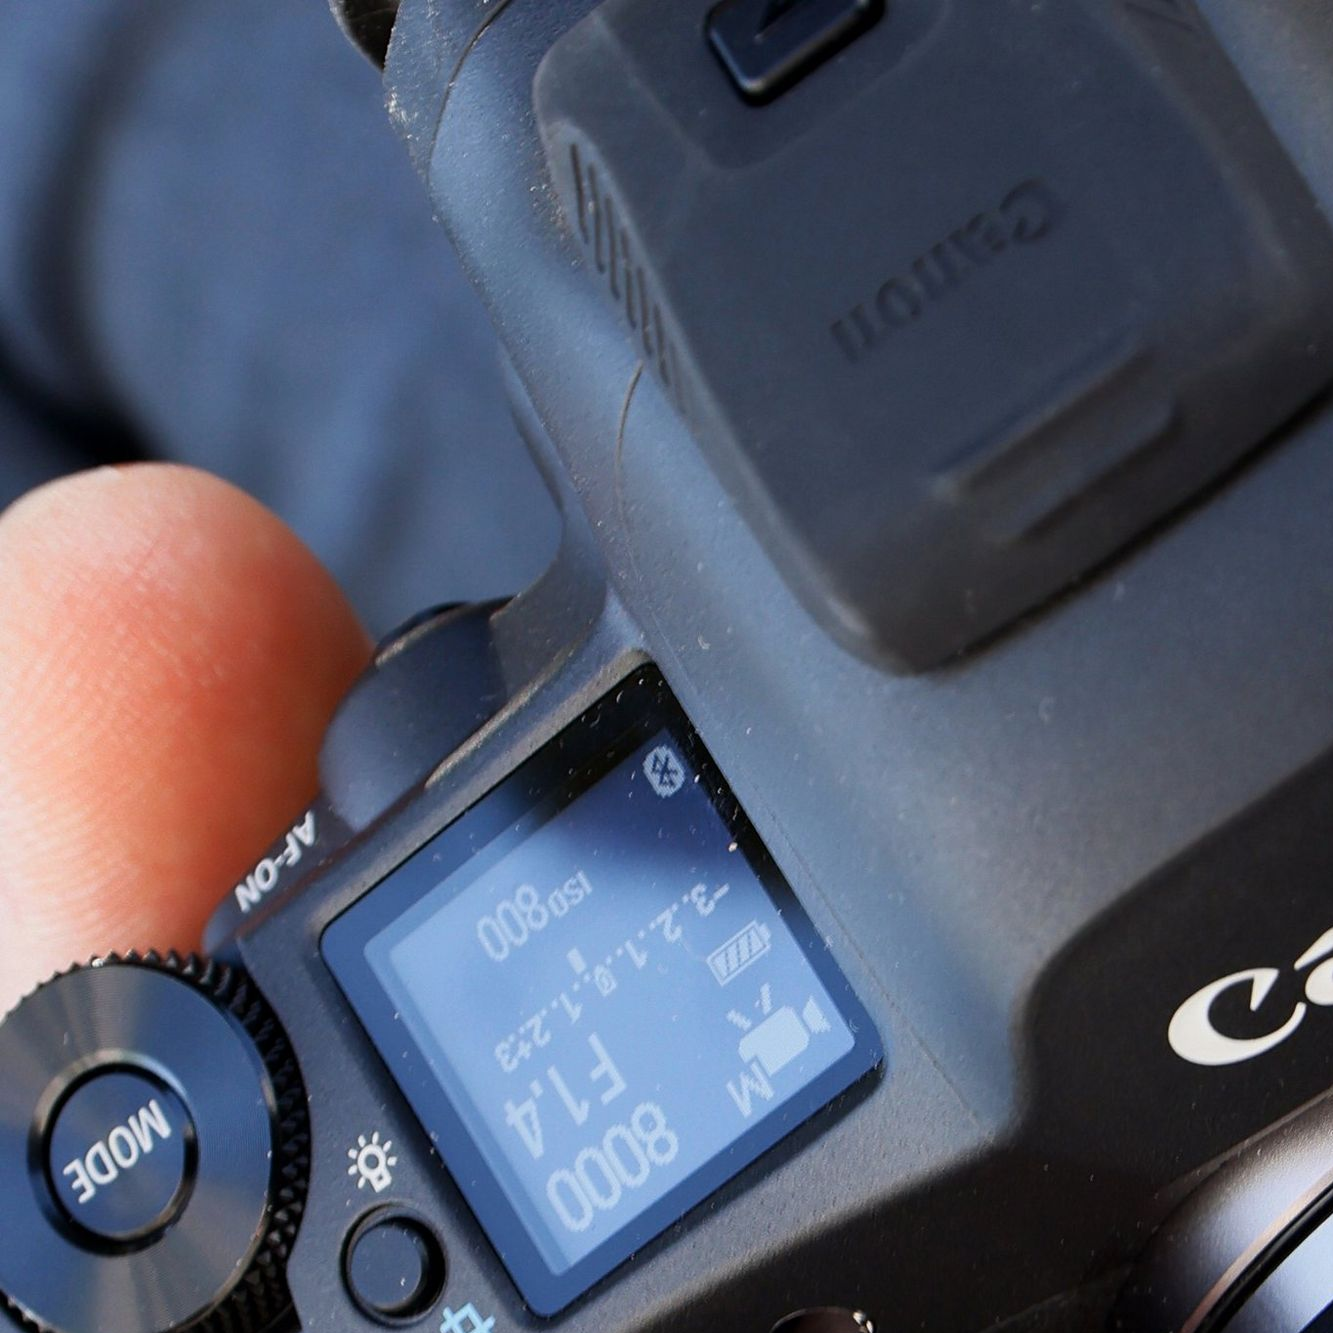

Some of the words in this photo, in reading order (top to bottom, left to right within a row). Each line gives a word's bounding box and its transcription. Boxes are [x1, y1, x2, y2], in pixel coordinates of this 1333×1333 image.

[830, 176, 1068, 364] Canon
[235, 809, 315, 913] AF-ON
[726, 1061, 774, 1117] M
[63, 1099, 171, 1204] MODE
[547, 1102, 678, 1232] 8000
